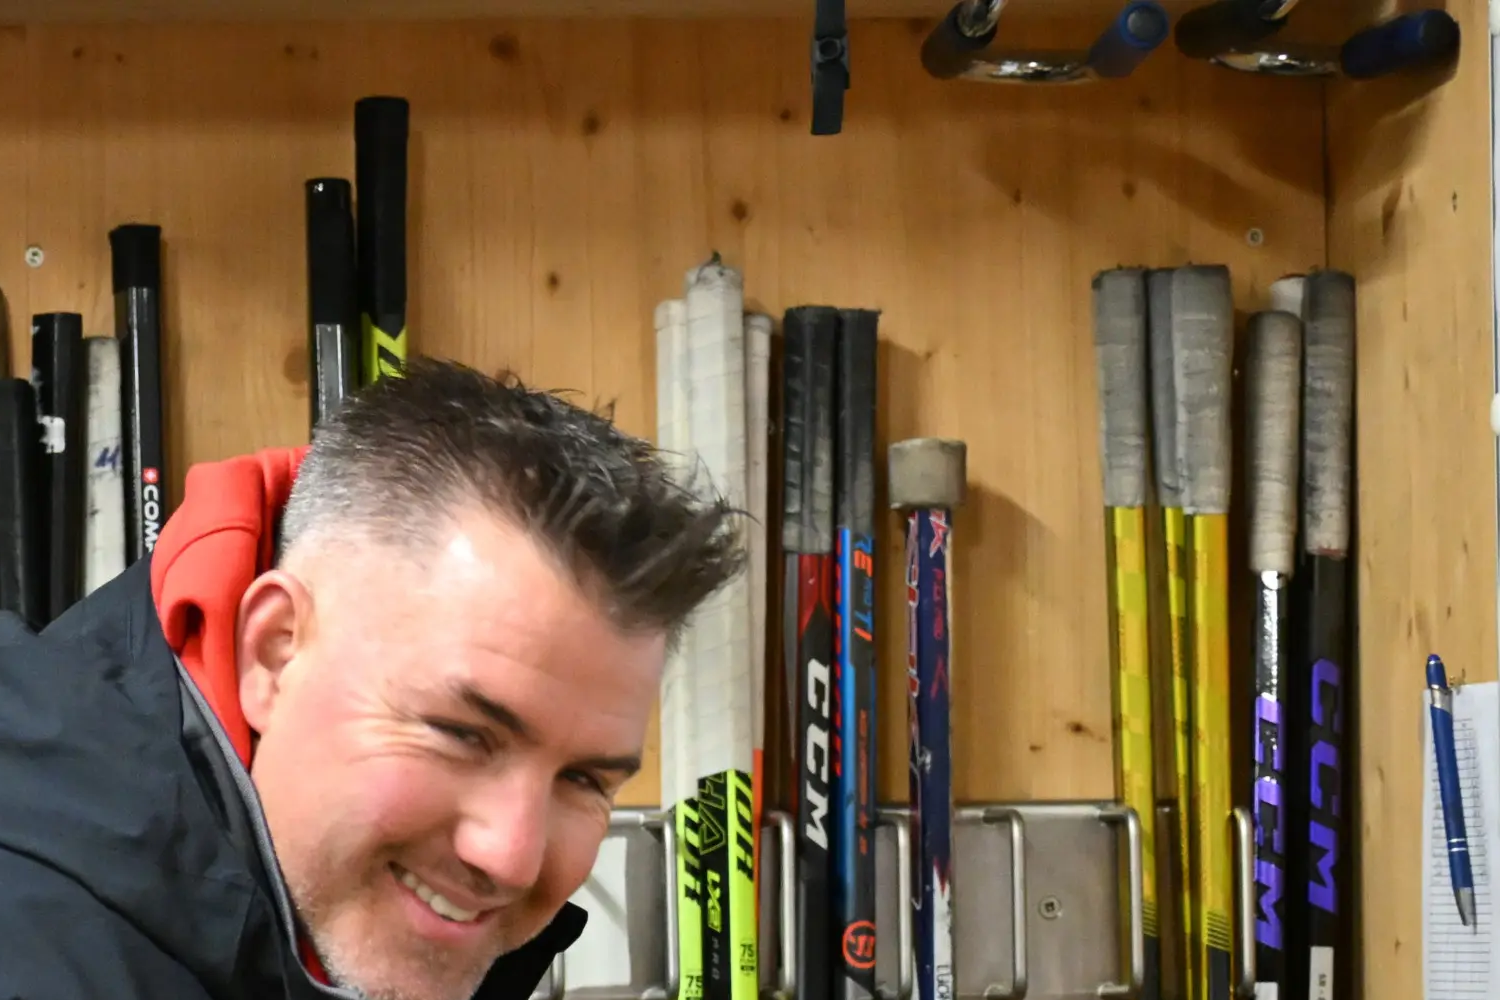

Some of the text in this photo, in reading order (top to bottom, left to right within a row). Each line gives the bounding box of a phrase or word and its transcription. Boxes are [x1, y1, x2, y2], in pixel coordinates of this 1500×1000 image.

[805, 657, 830, 851] CCM
[1254, 694, 1283, 950] CCM
[1308, 658, 1342, 914] CCM
